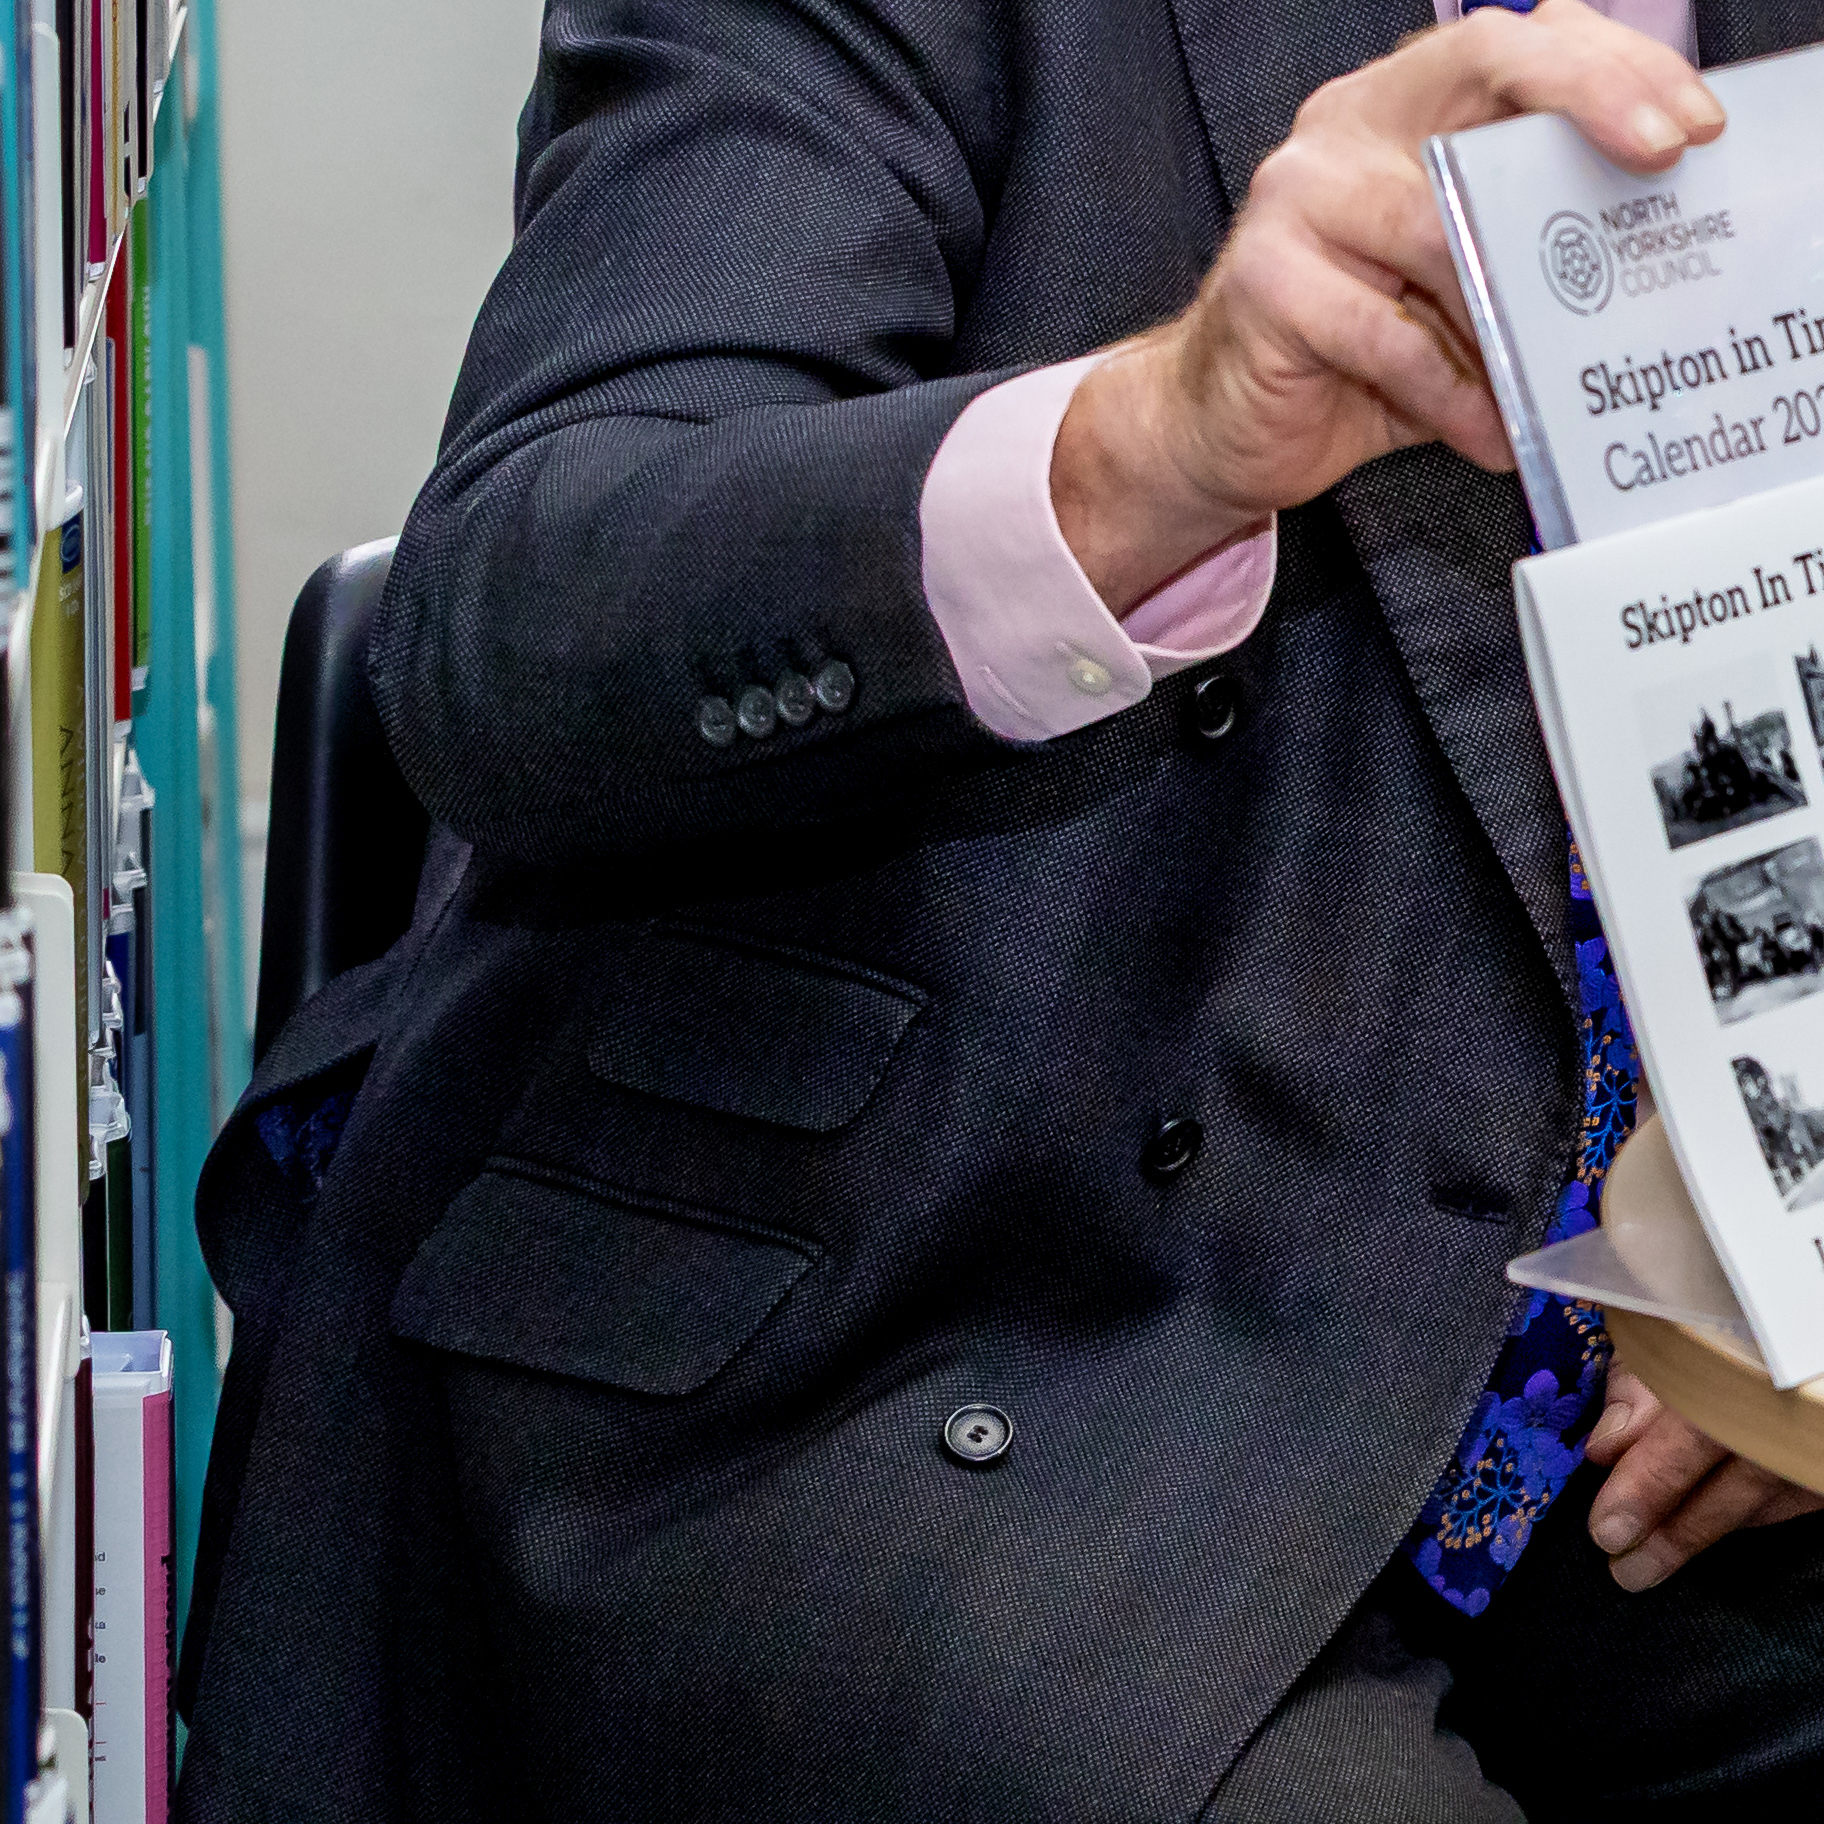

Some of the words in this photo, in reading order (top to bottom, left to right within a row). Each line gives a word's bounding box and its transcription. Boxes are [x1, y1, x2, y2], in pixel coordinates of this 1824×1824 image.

[1601, 190, 1682, 234] NORTH
[1611, 209, 1737, 263] YORKSHIRE
[1619, 256, 1724, 300] COUNCIL
[1579, 346, 1728, 419] Skipton
[1730, 325, 1774, 375] in
[1603, 407, 1769, 493] Calendar
[1619, 580, 1751, 651] Skipton
[1752, 565, 1795, 611] In
[59, 725, 75, 883] ANNA
